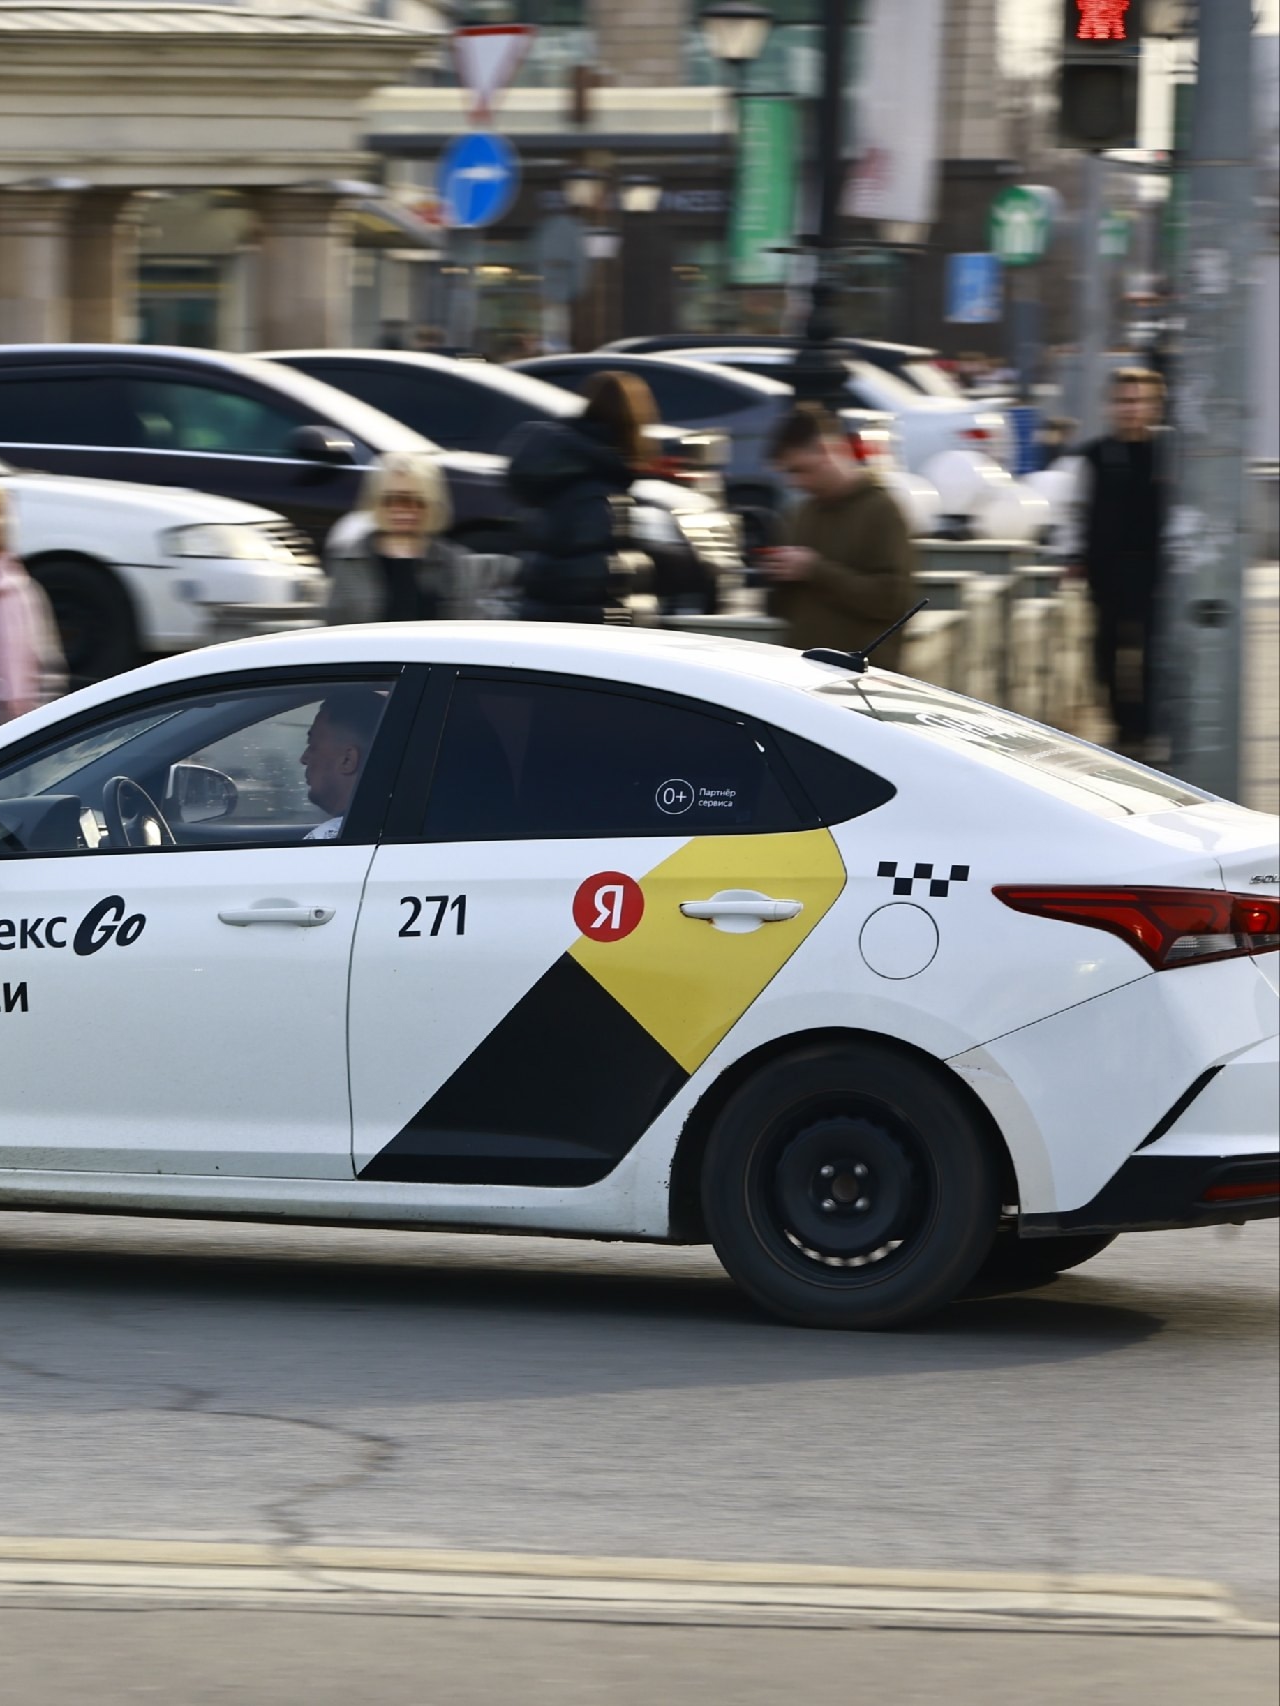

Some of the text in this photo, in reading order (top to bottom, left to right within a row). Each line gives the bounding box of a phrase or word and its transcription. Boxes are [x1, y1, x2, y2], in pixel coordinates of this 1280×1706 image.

[663, 787, 688, 805] 0+
[698, 799, 734, 808] сервиса
[73, 894, 147, 956] Go
[398, 894, 467, 938] 271
[589, 884, 624, 930] Я
